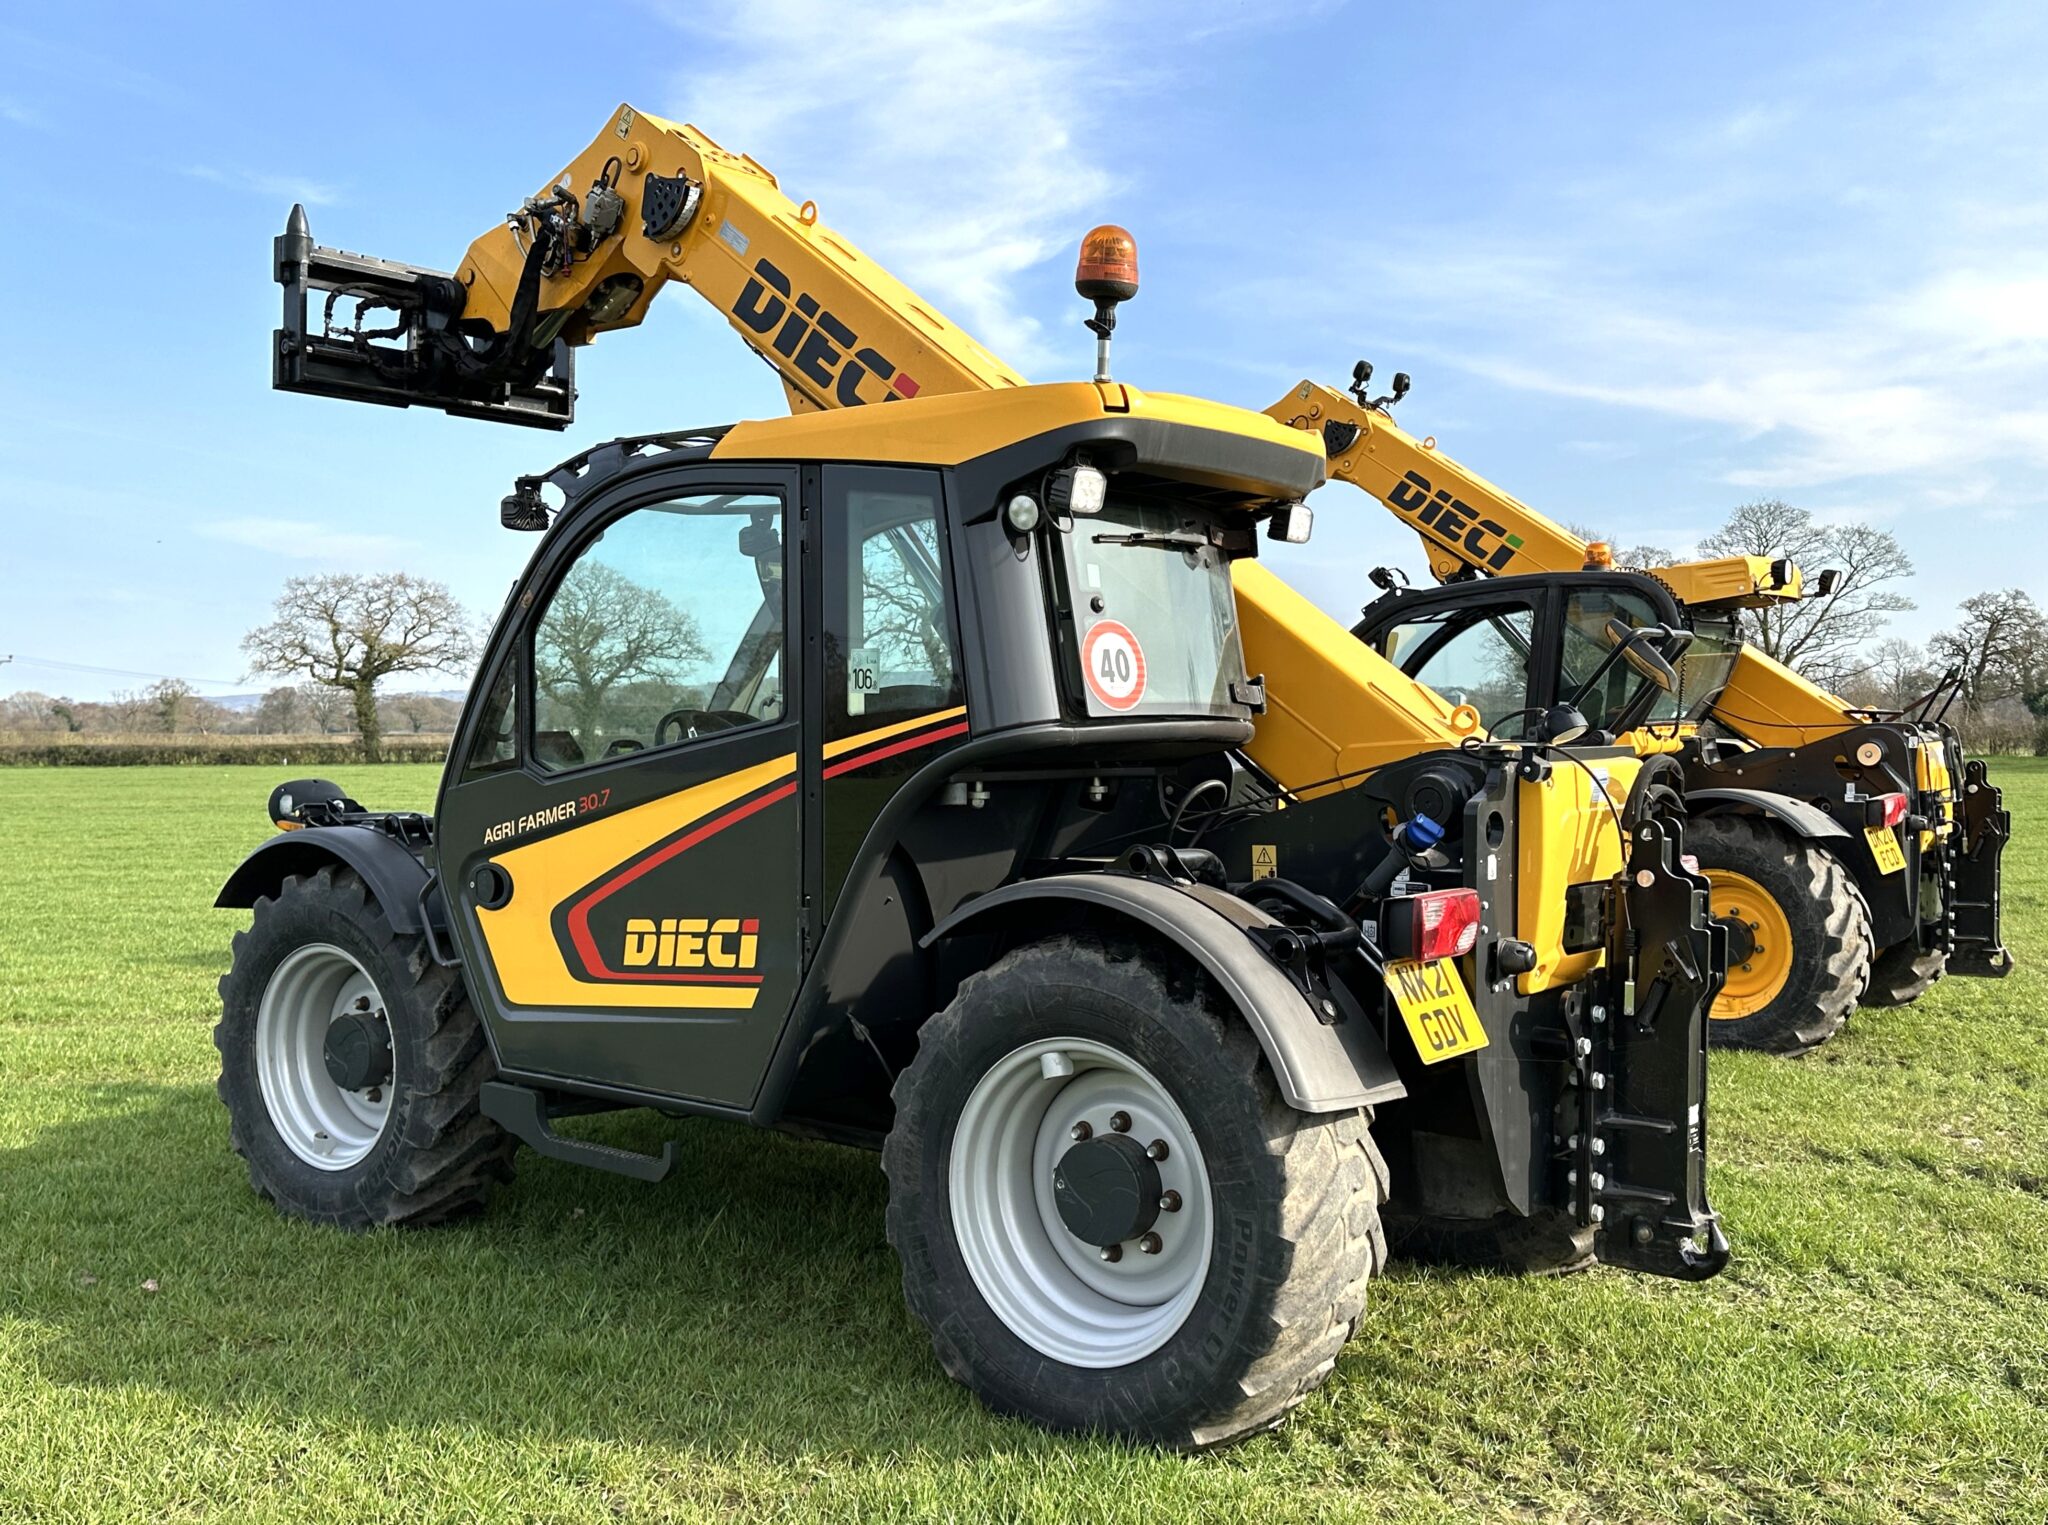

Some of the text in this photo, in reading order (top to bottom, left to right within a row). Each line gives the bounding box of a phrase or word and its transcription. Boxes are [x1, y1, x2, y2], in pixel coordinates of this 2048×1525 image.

[853, 668, 873, 690] 106
[1101, 648, 1130, 683] 40
[483, 788, 611, 845] AGRI FARMER 30.7
[1879, 847, 1900, 869] FCD
[1395, 960, 1455, 1006] NK21
[1419, 1003, 1469, 1052] GDV
